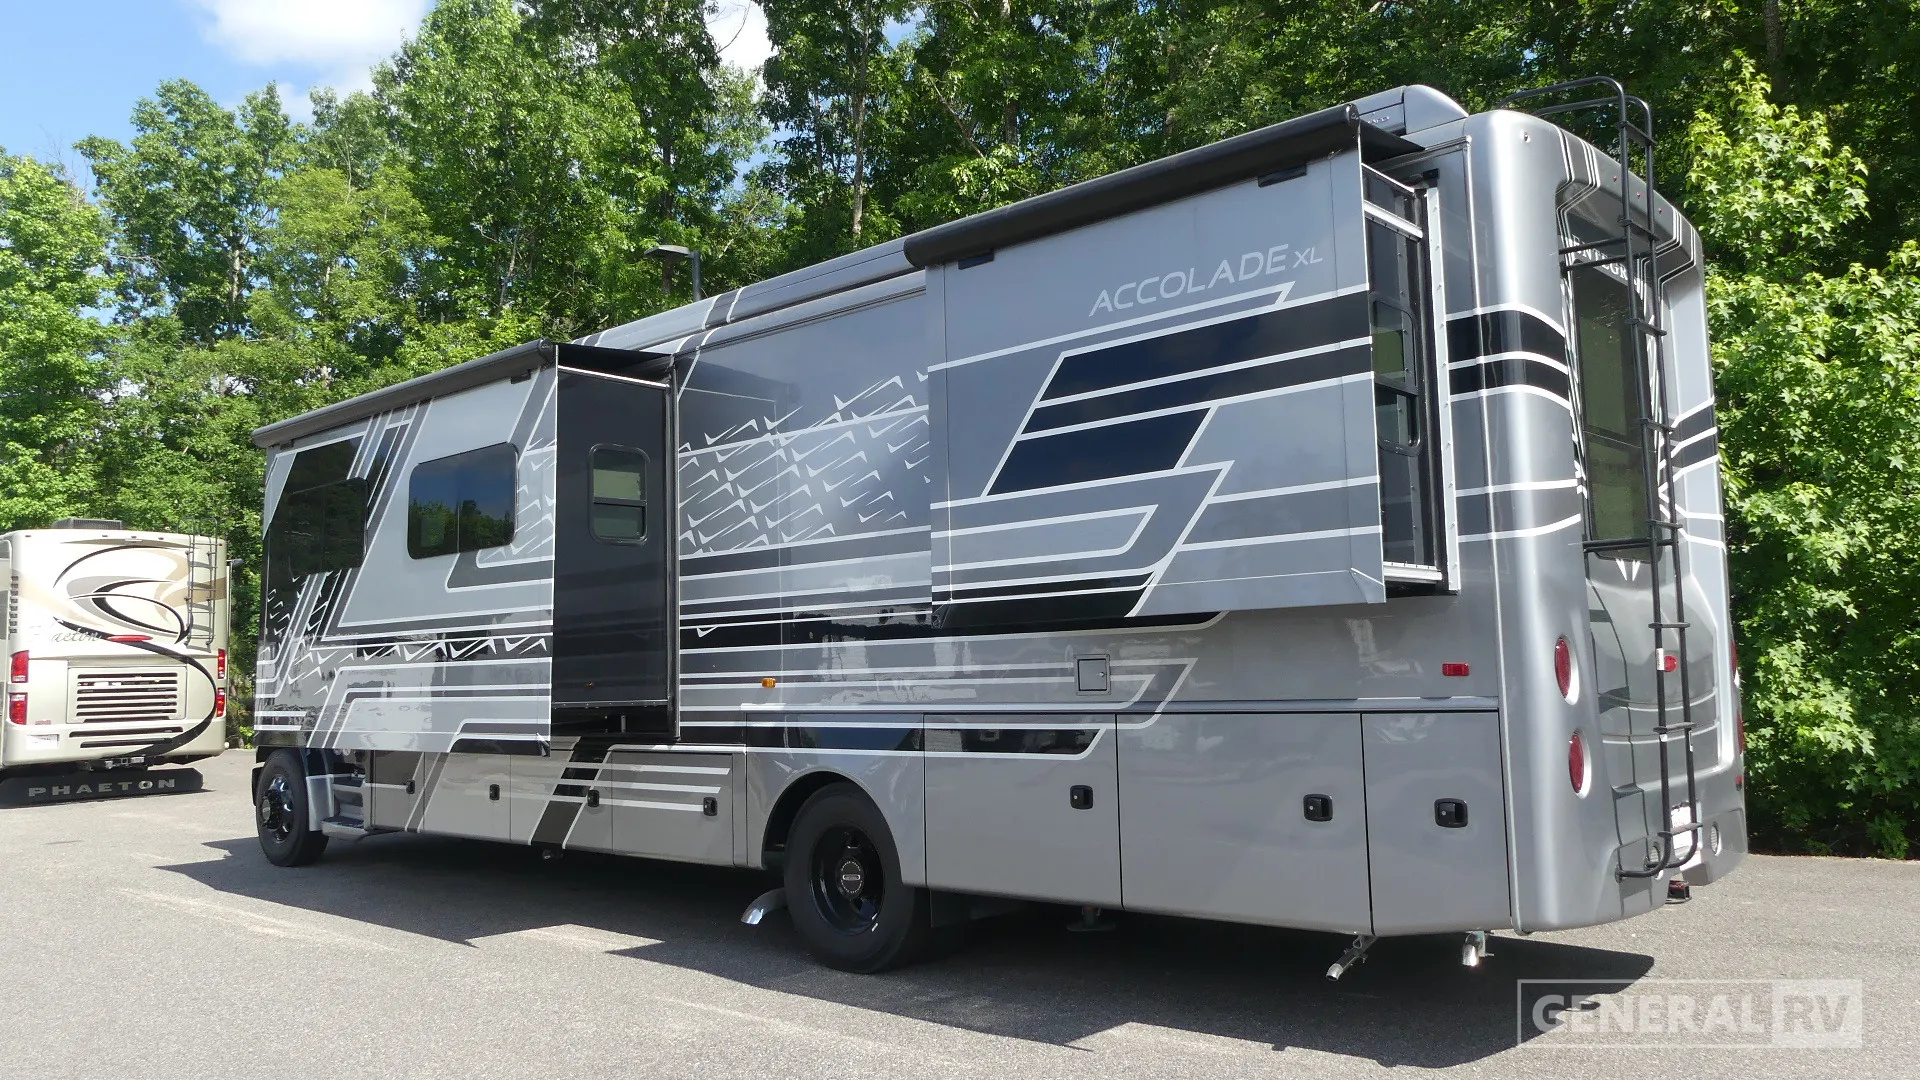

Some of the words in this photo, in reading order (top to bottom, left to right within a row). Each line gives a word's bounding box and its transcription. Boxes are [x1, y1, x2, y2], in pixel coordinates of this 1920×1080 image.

[1088, 243, 1289, 317] ACCOLADE
[1292, 246, 1323, 269] XL
[28, 778, 175, 797] PHAETON
